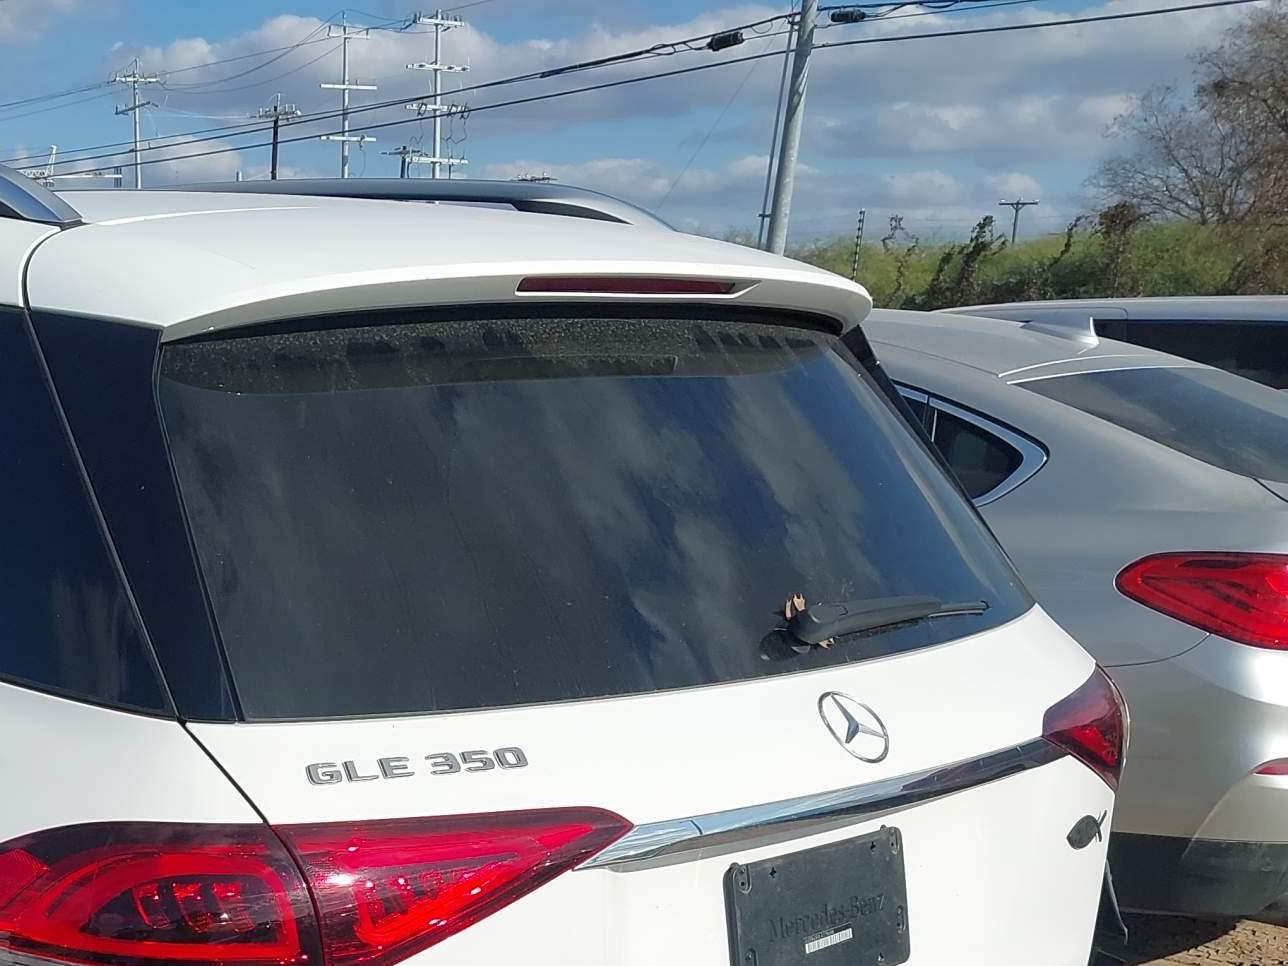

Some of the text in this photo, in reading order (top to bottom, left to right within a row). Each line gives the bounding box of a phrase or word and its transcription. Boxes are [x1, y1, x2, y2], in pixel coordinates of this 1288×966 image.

[305, 746, 529, 785] GLE 350
[768, 892, 886, 943] Mercedes-Benz
